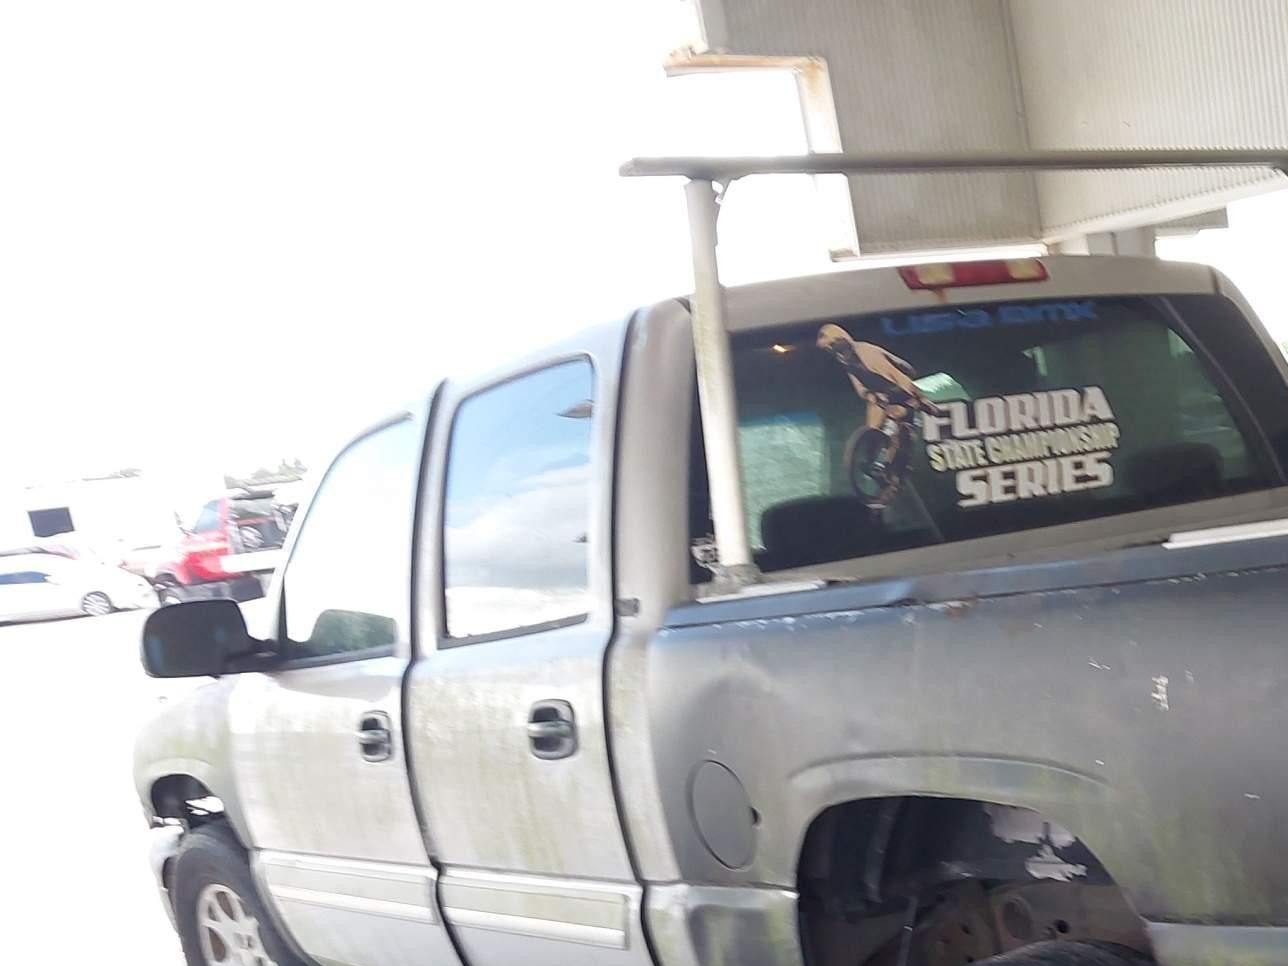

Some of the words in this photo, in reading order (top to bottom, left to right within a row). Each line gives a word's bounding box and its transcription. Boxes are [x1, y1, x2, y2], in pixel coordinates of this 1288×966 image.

[922, 386, 1115, 442] FLORIDA
[927, 438, 988, 471] STATE
[985, 422, 1121, 464] CHAMPIONSHIP
[956, 451, 1114, 508] SERIES
